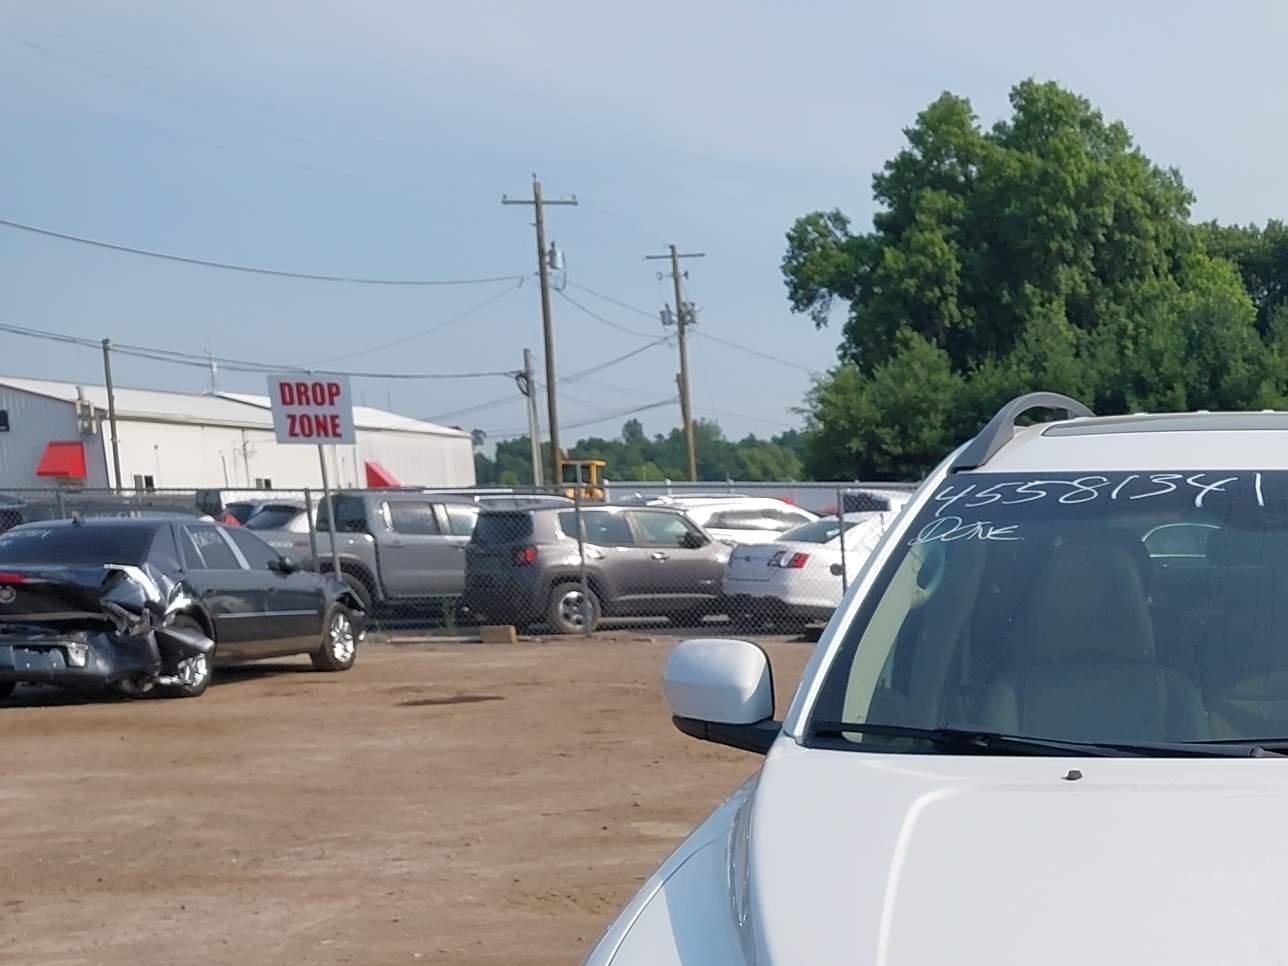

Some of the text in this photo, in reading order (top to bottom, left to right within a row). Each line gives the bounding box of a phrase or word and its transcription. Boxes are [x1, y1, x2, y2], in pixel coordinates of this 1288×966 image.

[279, 382, 341, 406] DROP
[286, 414, 342, 438] ZONE
[935, 472, 1264, 517] 45581341
